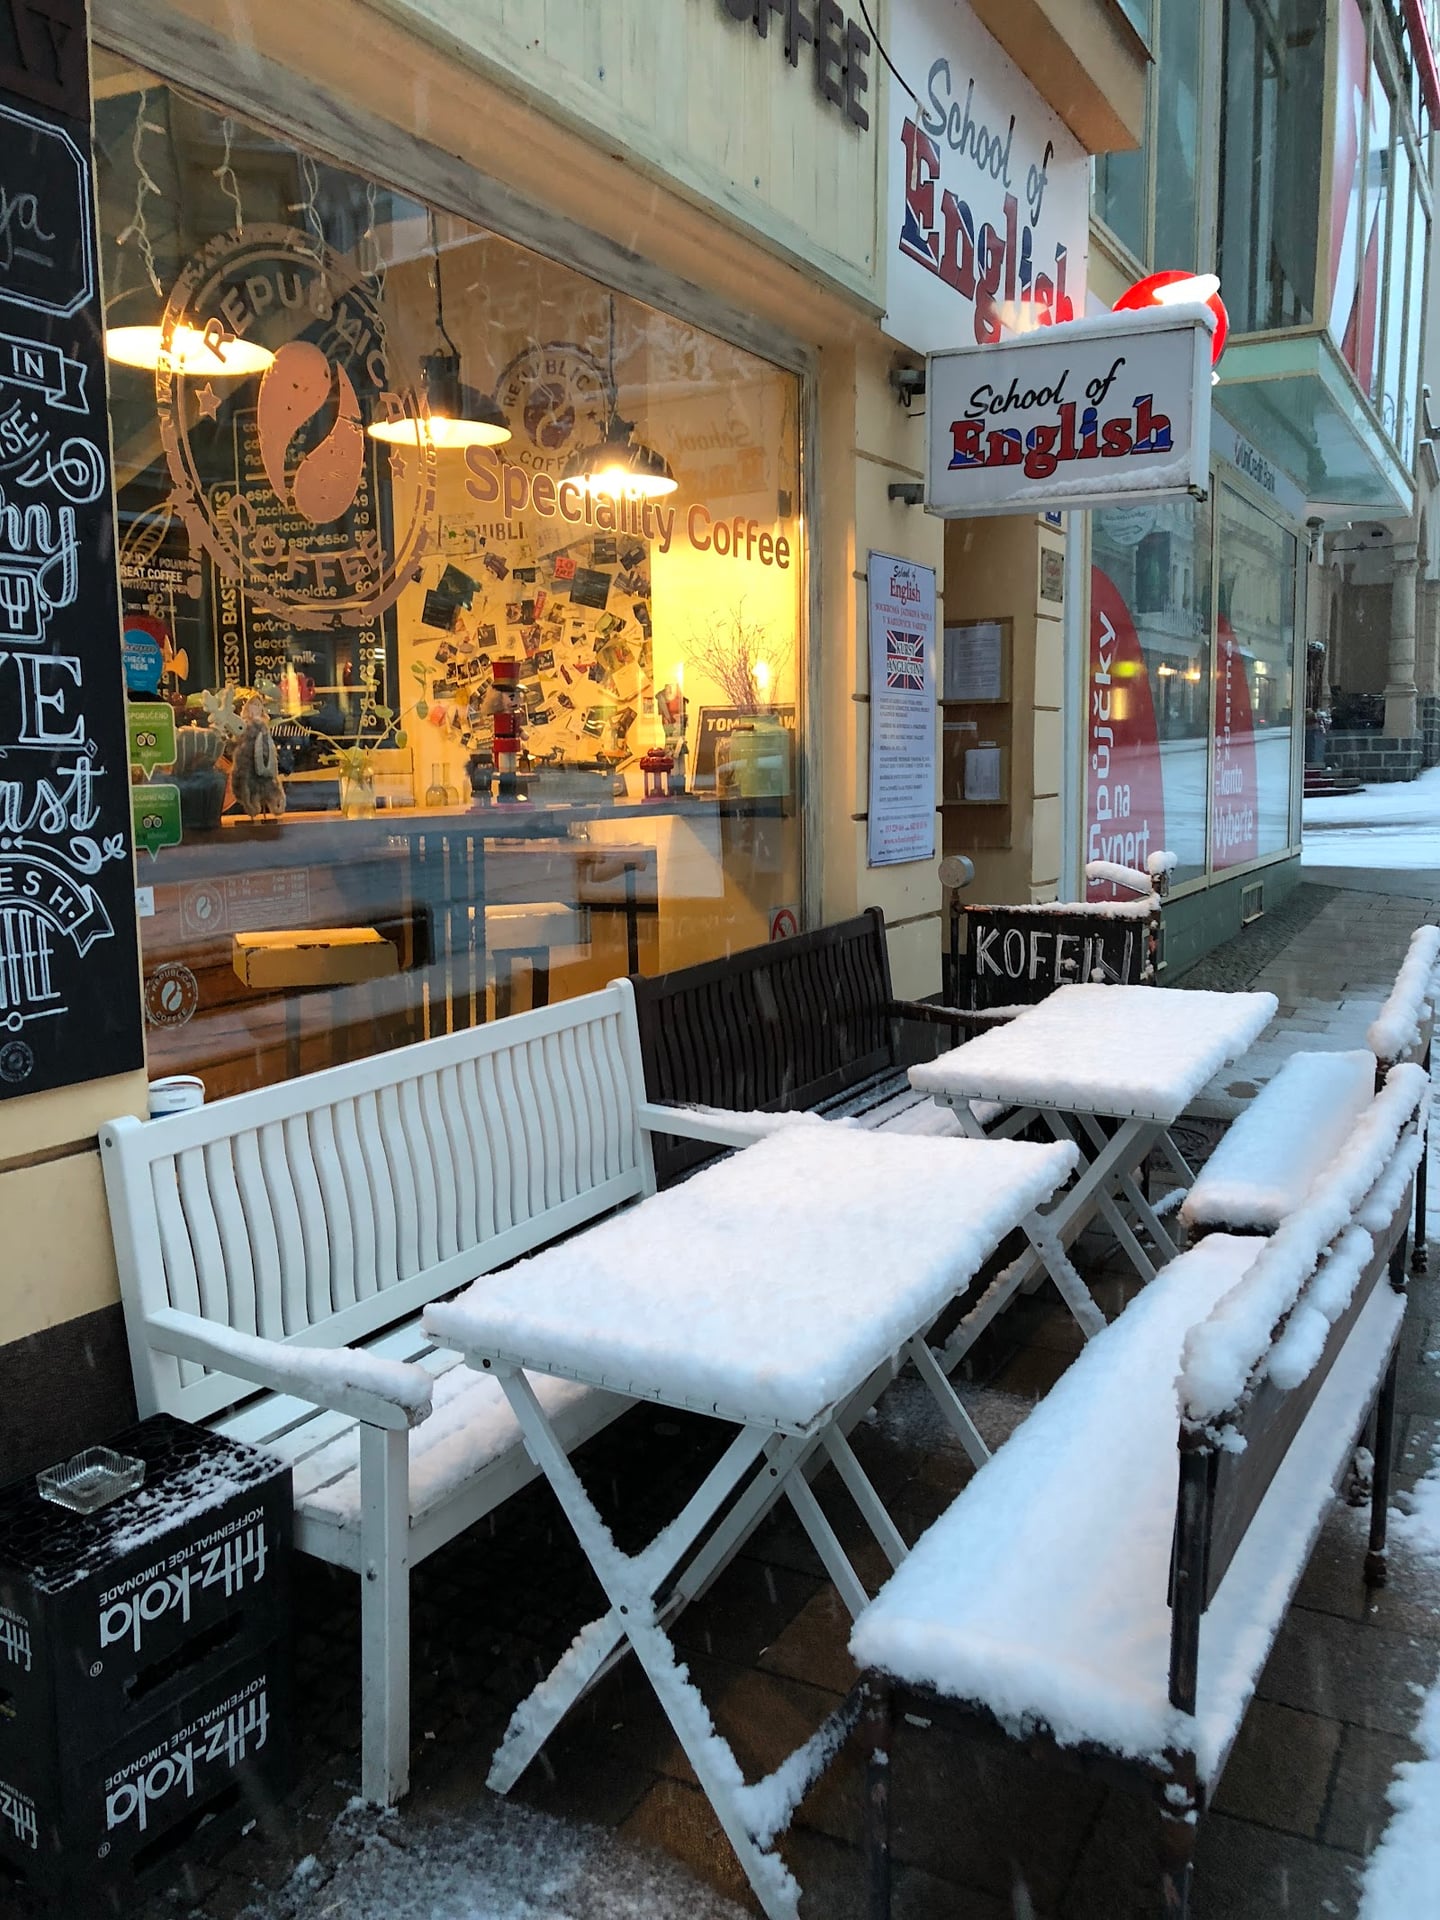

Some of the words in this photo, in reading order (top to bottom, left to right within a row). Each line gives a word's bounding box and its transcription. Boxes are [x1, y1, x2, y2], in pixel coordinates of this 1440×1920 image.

[922, 57, 1016, 189] School
[1026, 140, 1054, 228] of
[899, 116, 1075, 344] English
[12, 346, 45, 379] IN
[964, 369, 1070, 418] School
[1085, 357, 1126, 406] of
[947, 393, 1174, 480] English
[353, 511, 370, 525] 49
[464, 445, 675, 553] Speciality
[687, 504, 790, 569] Coffee
[228, 494, 388, 591] COFFEE
[287, 532, 349, 550] espresso
[120, 564, 145, 578] REAT
[147, 569, 184, 582] COFFEE
[219, 571, 238, 626] BASE
[250, 569, 291, 585] mcha
[355, 581, 373, 593] 60
[889, 576, 921, 606] English
[252, 618, 291, 633] extra
[359, 632, 376, 644] 20
[222, 631, 240, 688] RESSO
[254, 655, 287, 670] soya
[291, 650, 316, 664] milk
[359, 648, 376, 661] 20
[1091, 611, 1117, 820] půjčky
[1113, 784, 1131, 818] na
[976, 921, 1134, 985] KOFEIN
[155, 1008, 188, 1023] COFFEE
[168, 1505, 264, 1569] KOFFEINHALTIGE
[99, 1562, 166, 1607] LIMONADE
[99, 1523, 269, 1653] fritz-kola
[170, 1674, 266, 1748] KOFFEINHALTIGE
[104, 1740, 169, 1792] LIMONADE
[105, 1691, 271, 1833] fritz-kola
